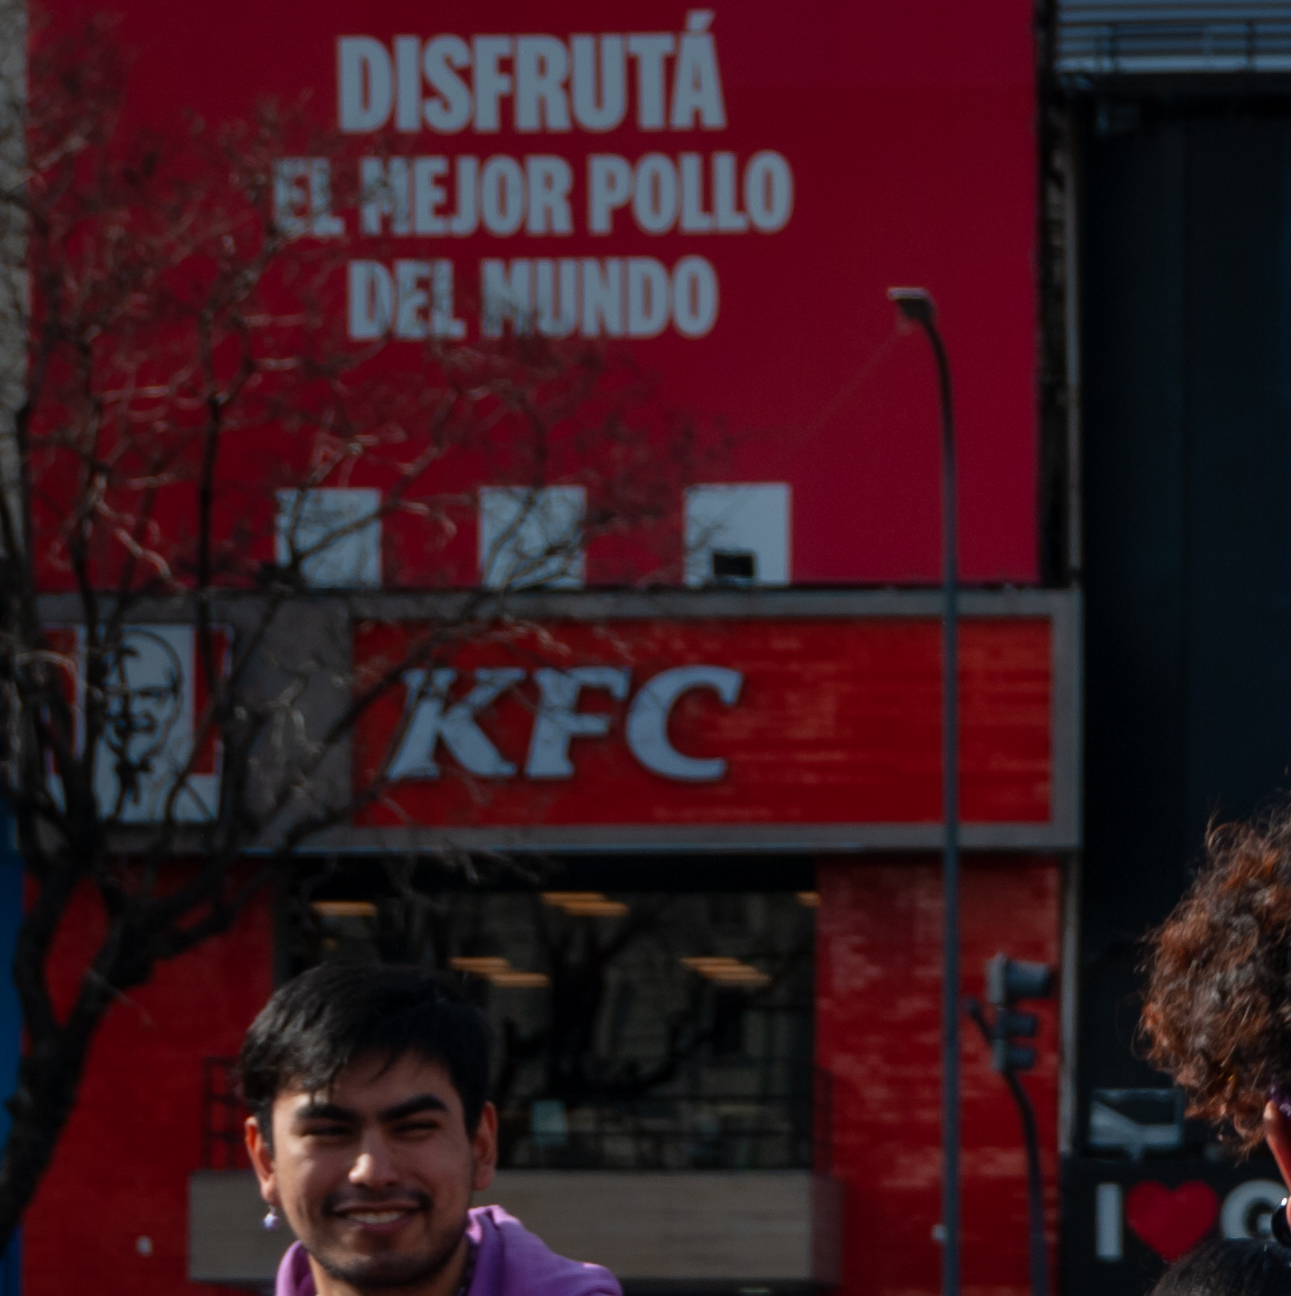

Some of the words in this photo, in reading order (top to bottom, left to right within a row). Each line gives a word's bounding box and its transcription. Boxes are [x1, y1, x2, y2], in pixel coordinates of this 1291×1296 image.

[335, 9, 727, 133] DISFRUTÁ
[274, 157, 343, 237] EL
[360, 155, 574, 237] MEJOR
[587, 150, 796, 235] POLLO
[346, 258, 466, 341] DEL
[479, 255, 720, 340] MUNDO
[386, 665, 743, 781] KFC
